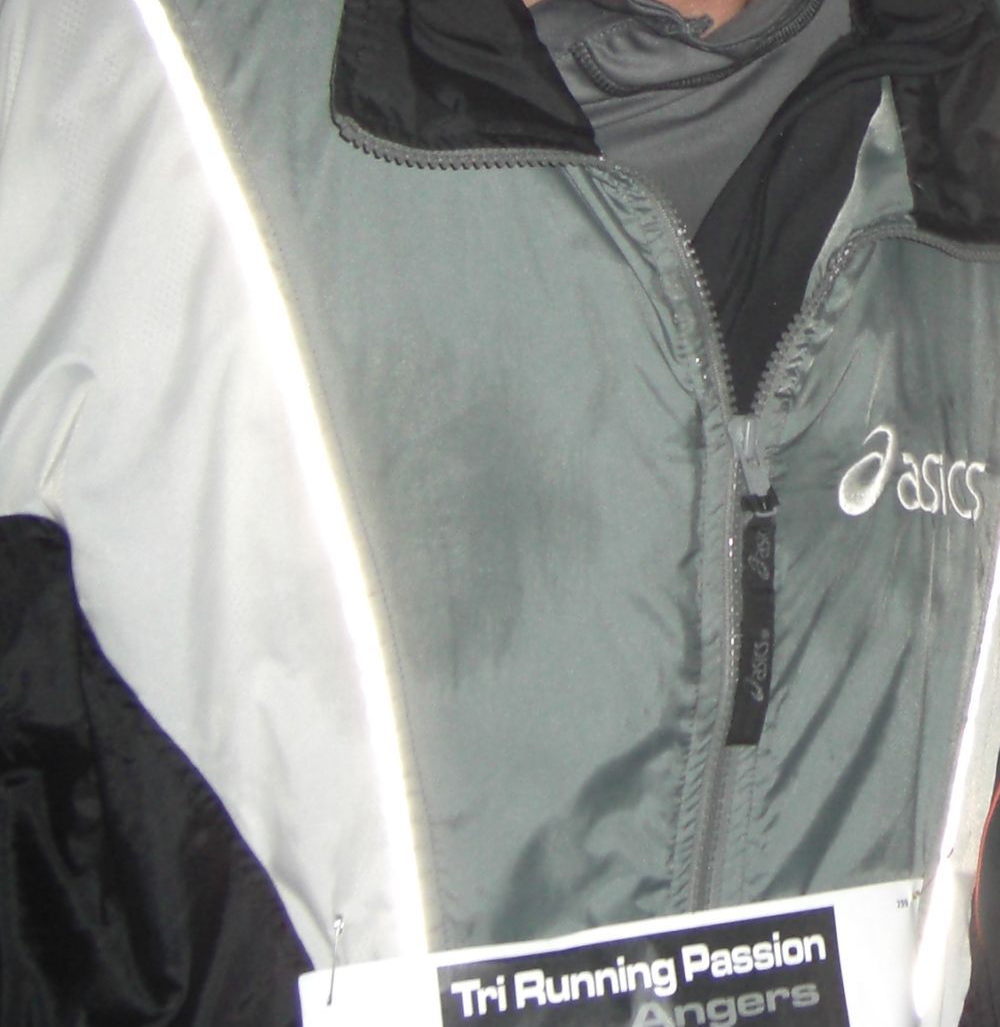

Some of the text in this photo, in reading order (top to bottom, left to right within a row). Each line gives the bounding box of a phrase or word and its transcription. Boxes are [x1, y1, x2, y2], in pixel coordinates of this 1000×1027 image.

[897, 452, 986, 522] asics
[450, 931, 827, 1018] Tri Running Passion
[631, 981, 821, 1027] Angers
